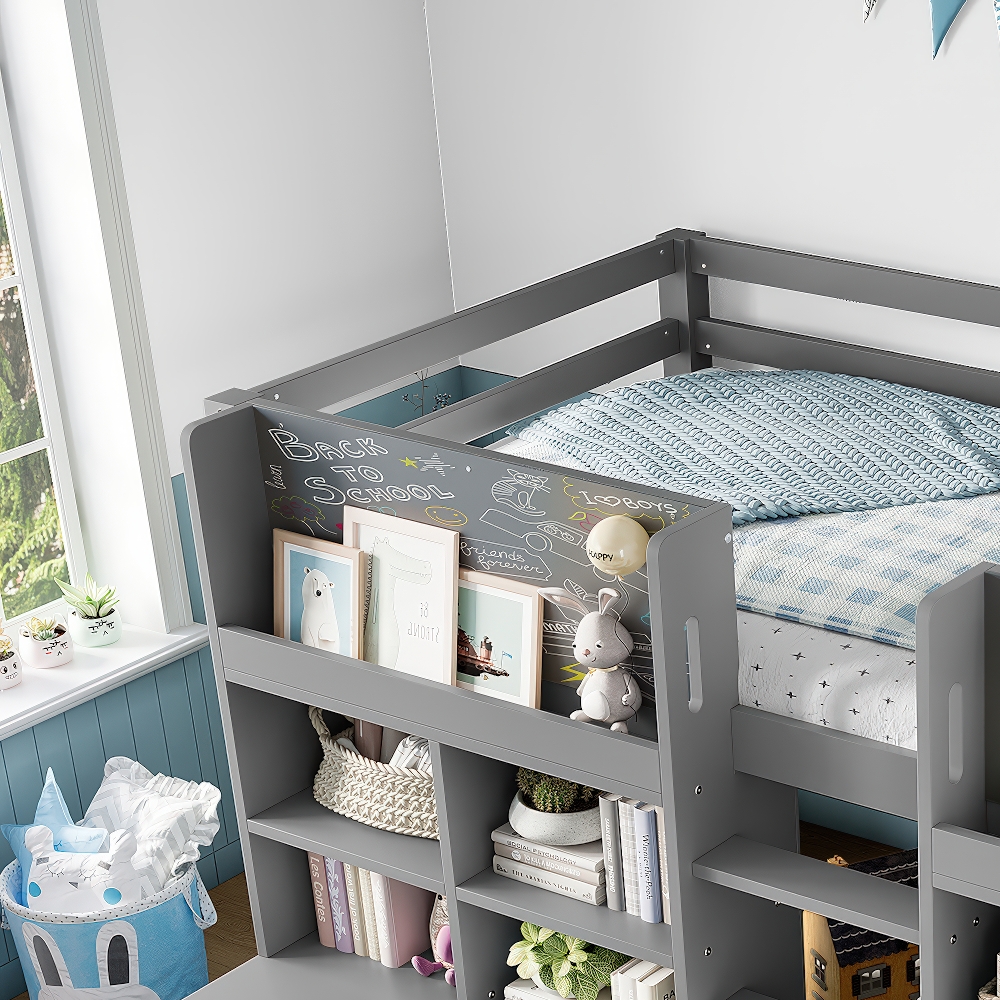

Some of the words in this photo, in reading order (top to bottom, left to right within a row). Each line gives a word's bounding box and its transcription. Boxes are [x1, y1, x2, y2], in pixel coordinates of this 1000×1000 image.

[330, 465, 384, 483] TO
[578, 490, 598, 505] I
[622, 497, 678, 515] BOYS
[460, 541, 525, 563] friends
[588, 549, 613, 562] HAPPY
[310, 856, 320, 878] Les
[313, 882, 326, 923] Contes
